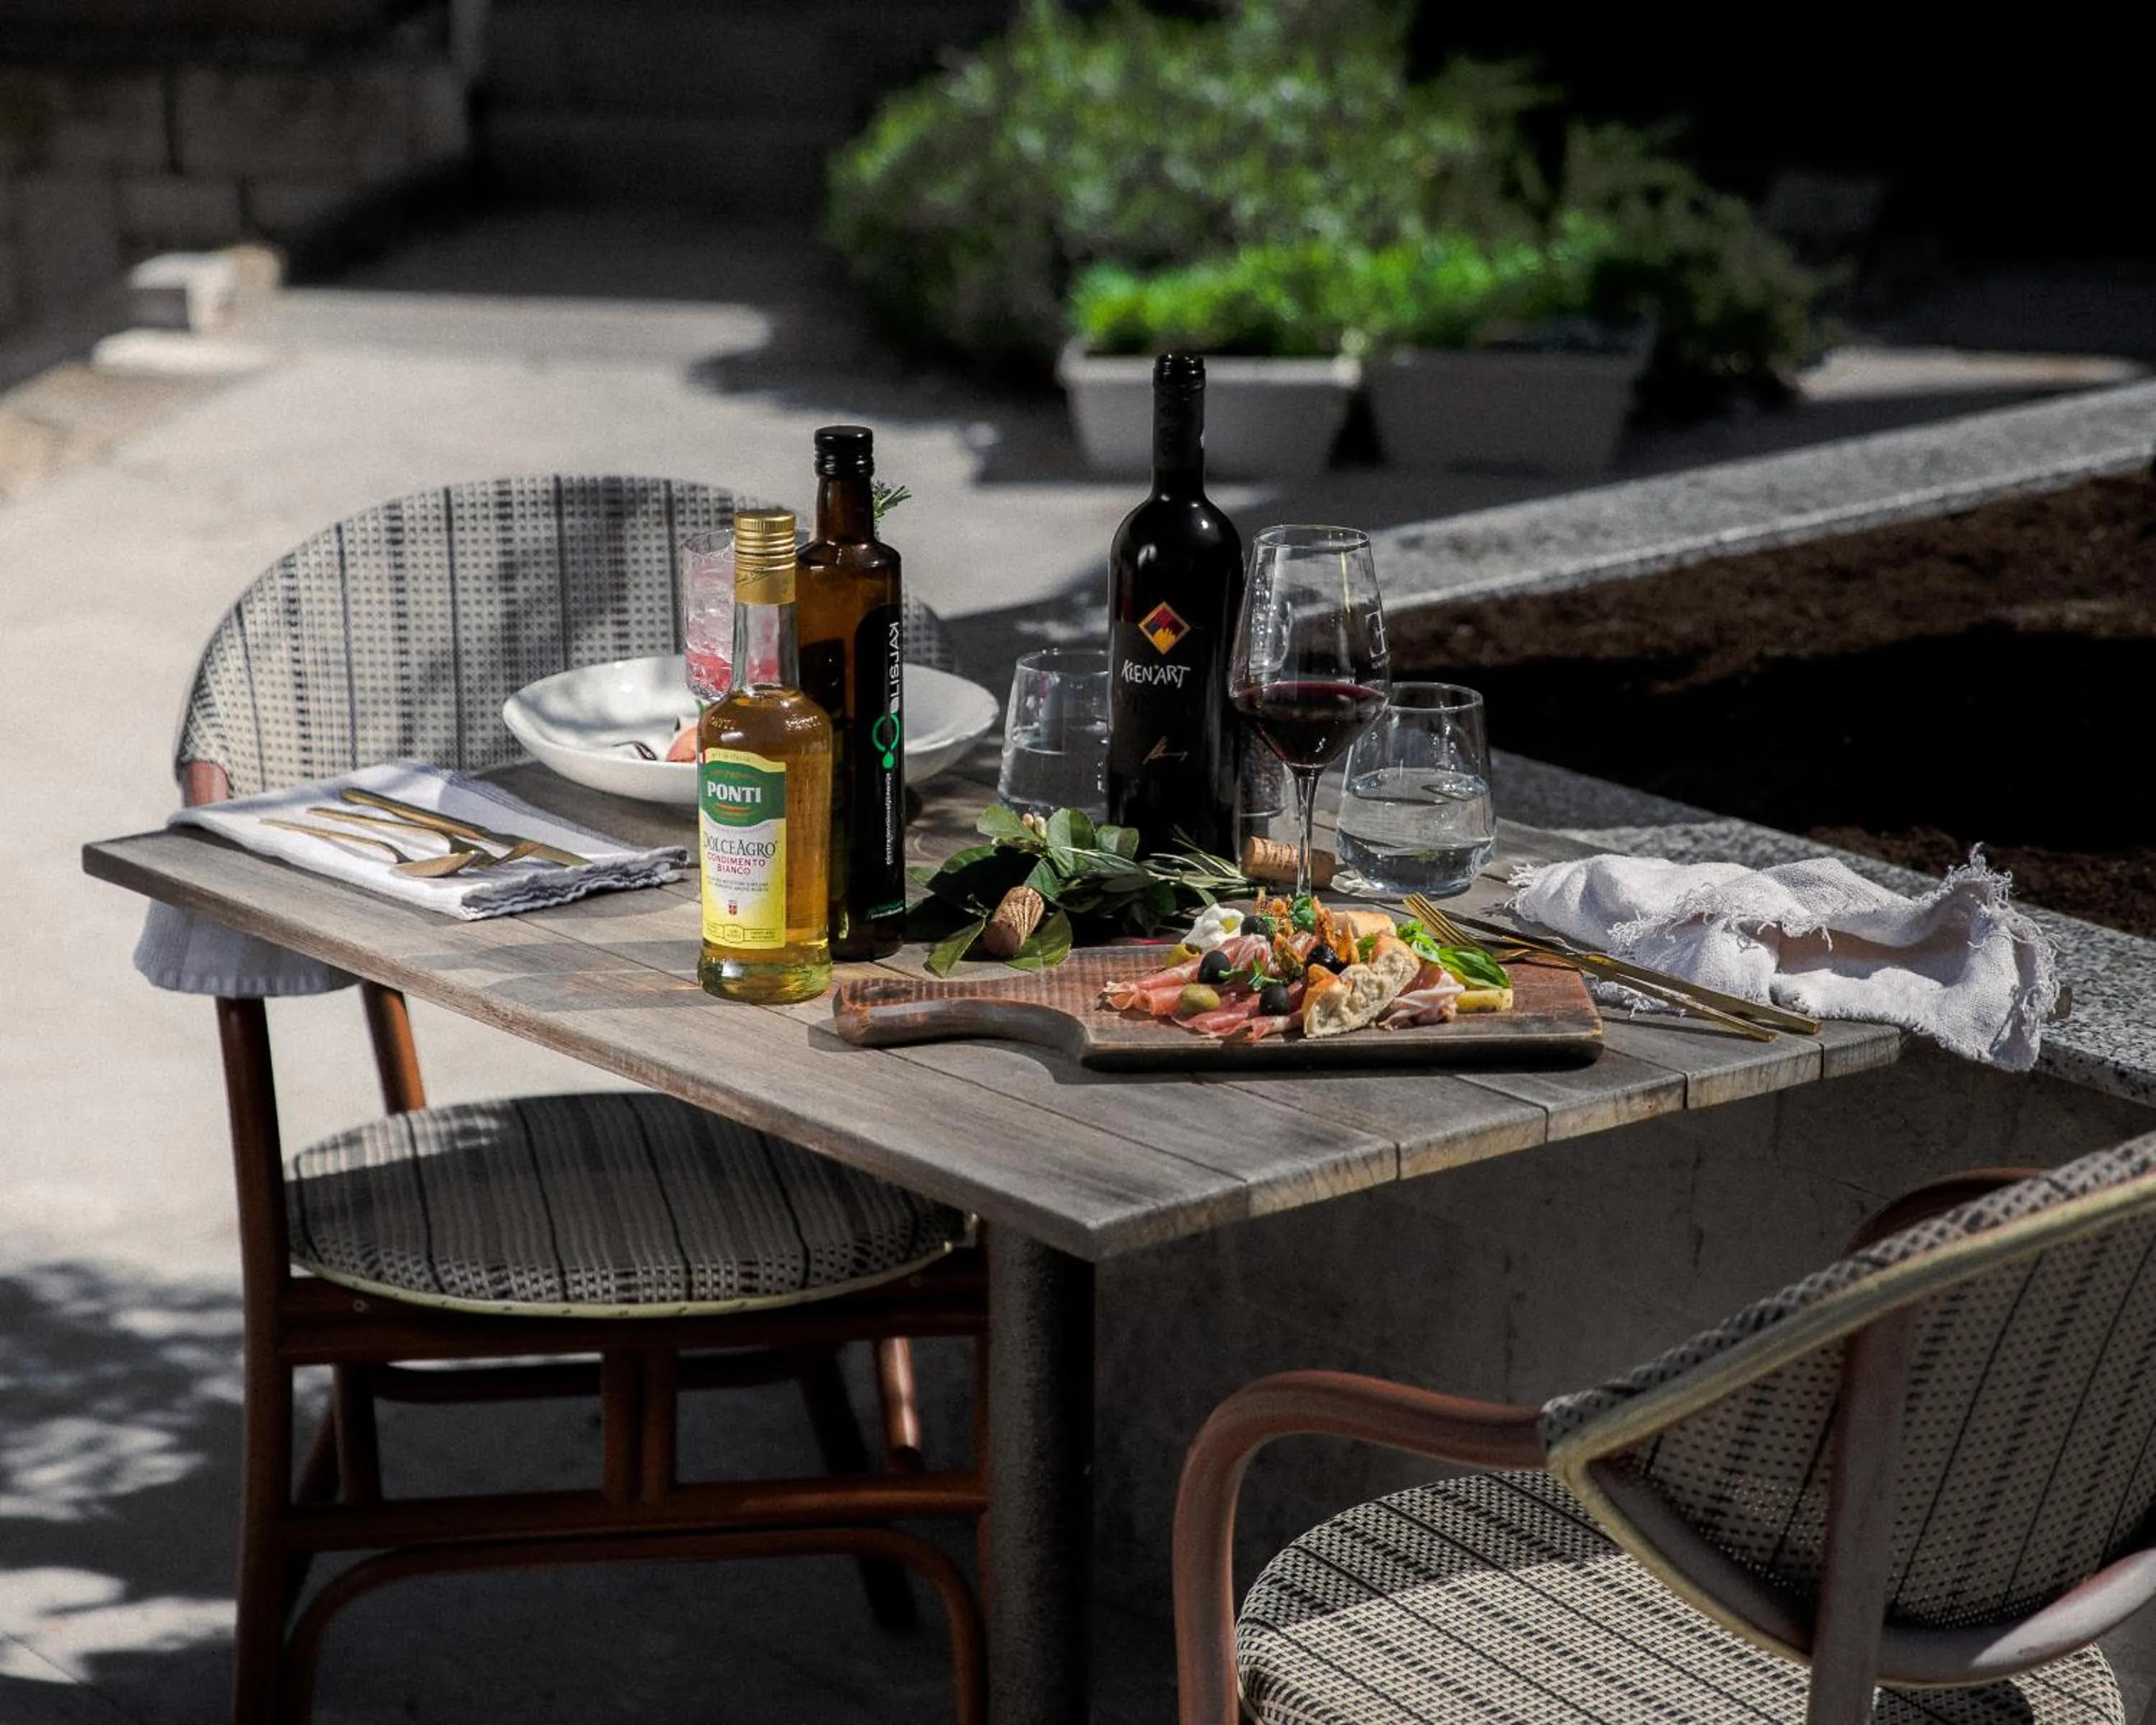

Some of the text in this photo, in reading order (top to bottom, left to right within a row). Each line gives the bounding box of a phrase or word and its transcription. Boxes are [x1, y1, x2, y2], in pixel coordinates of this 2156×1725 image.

[707, 782, 762, 803] PONTI
[706, 852, 766, 868] CONDIMENTO
[717, 864, 752, 875] BIANCO
